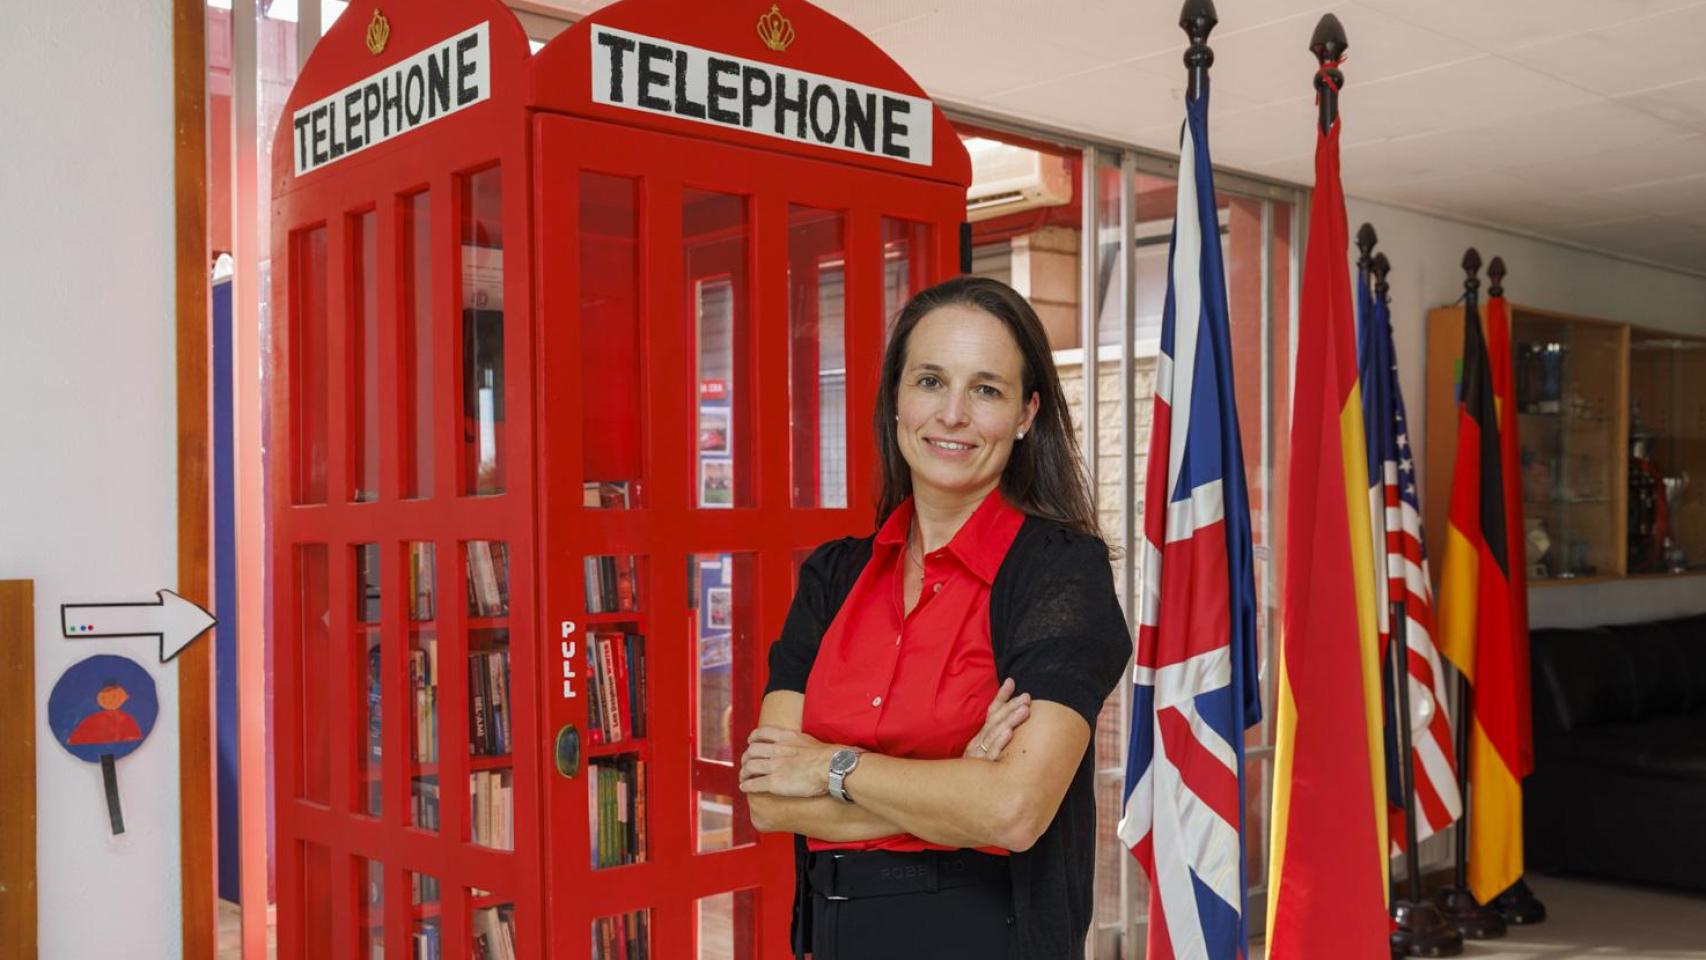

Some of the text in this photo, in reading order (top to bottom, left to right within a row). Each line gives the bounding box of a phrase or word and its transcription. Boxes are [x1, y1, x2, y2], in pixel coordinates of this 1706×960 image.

[294, 34, 478, 170] TELEPHONE
[598, 33, 911, 159] TELEPHONE
[561, 621, 576, 698] PULL
